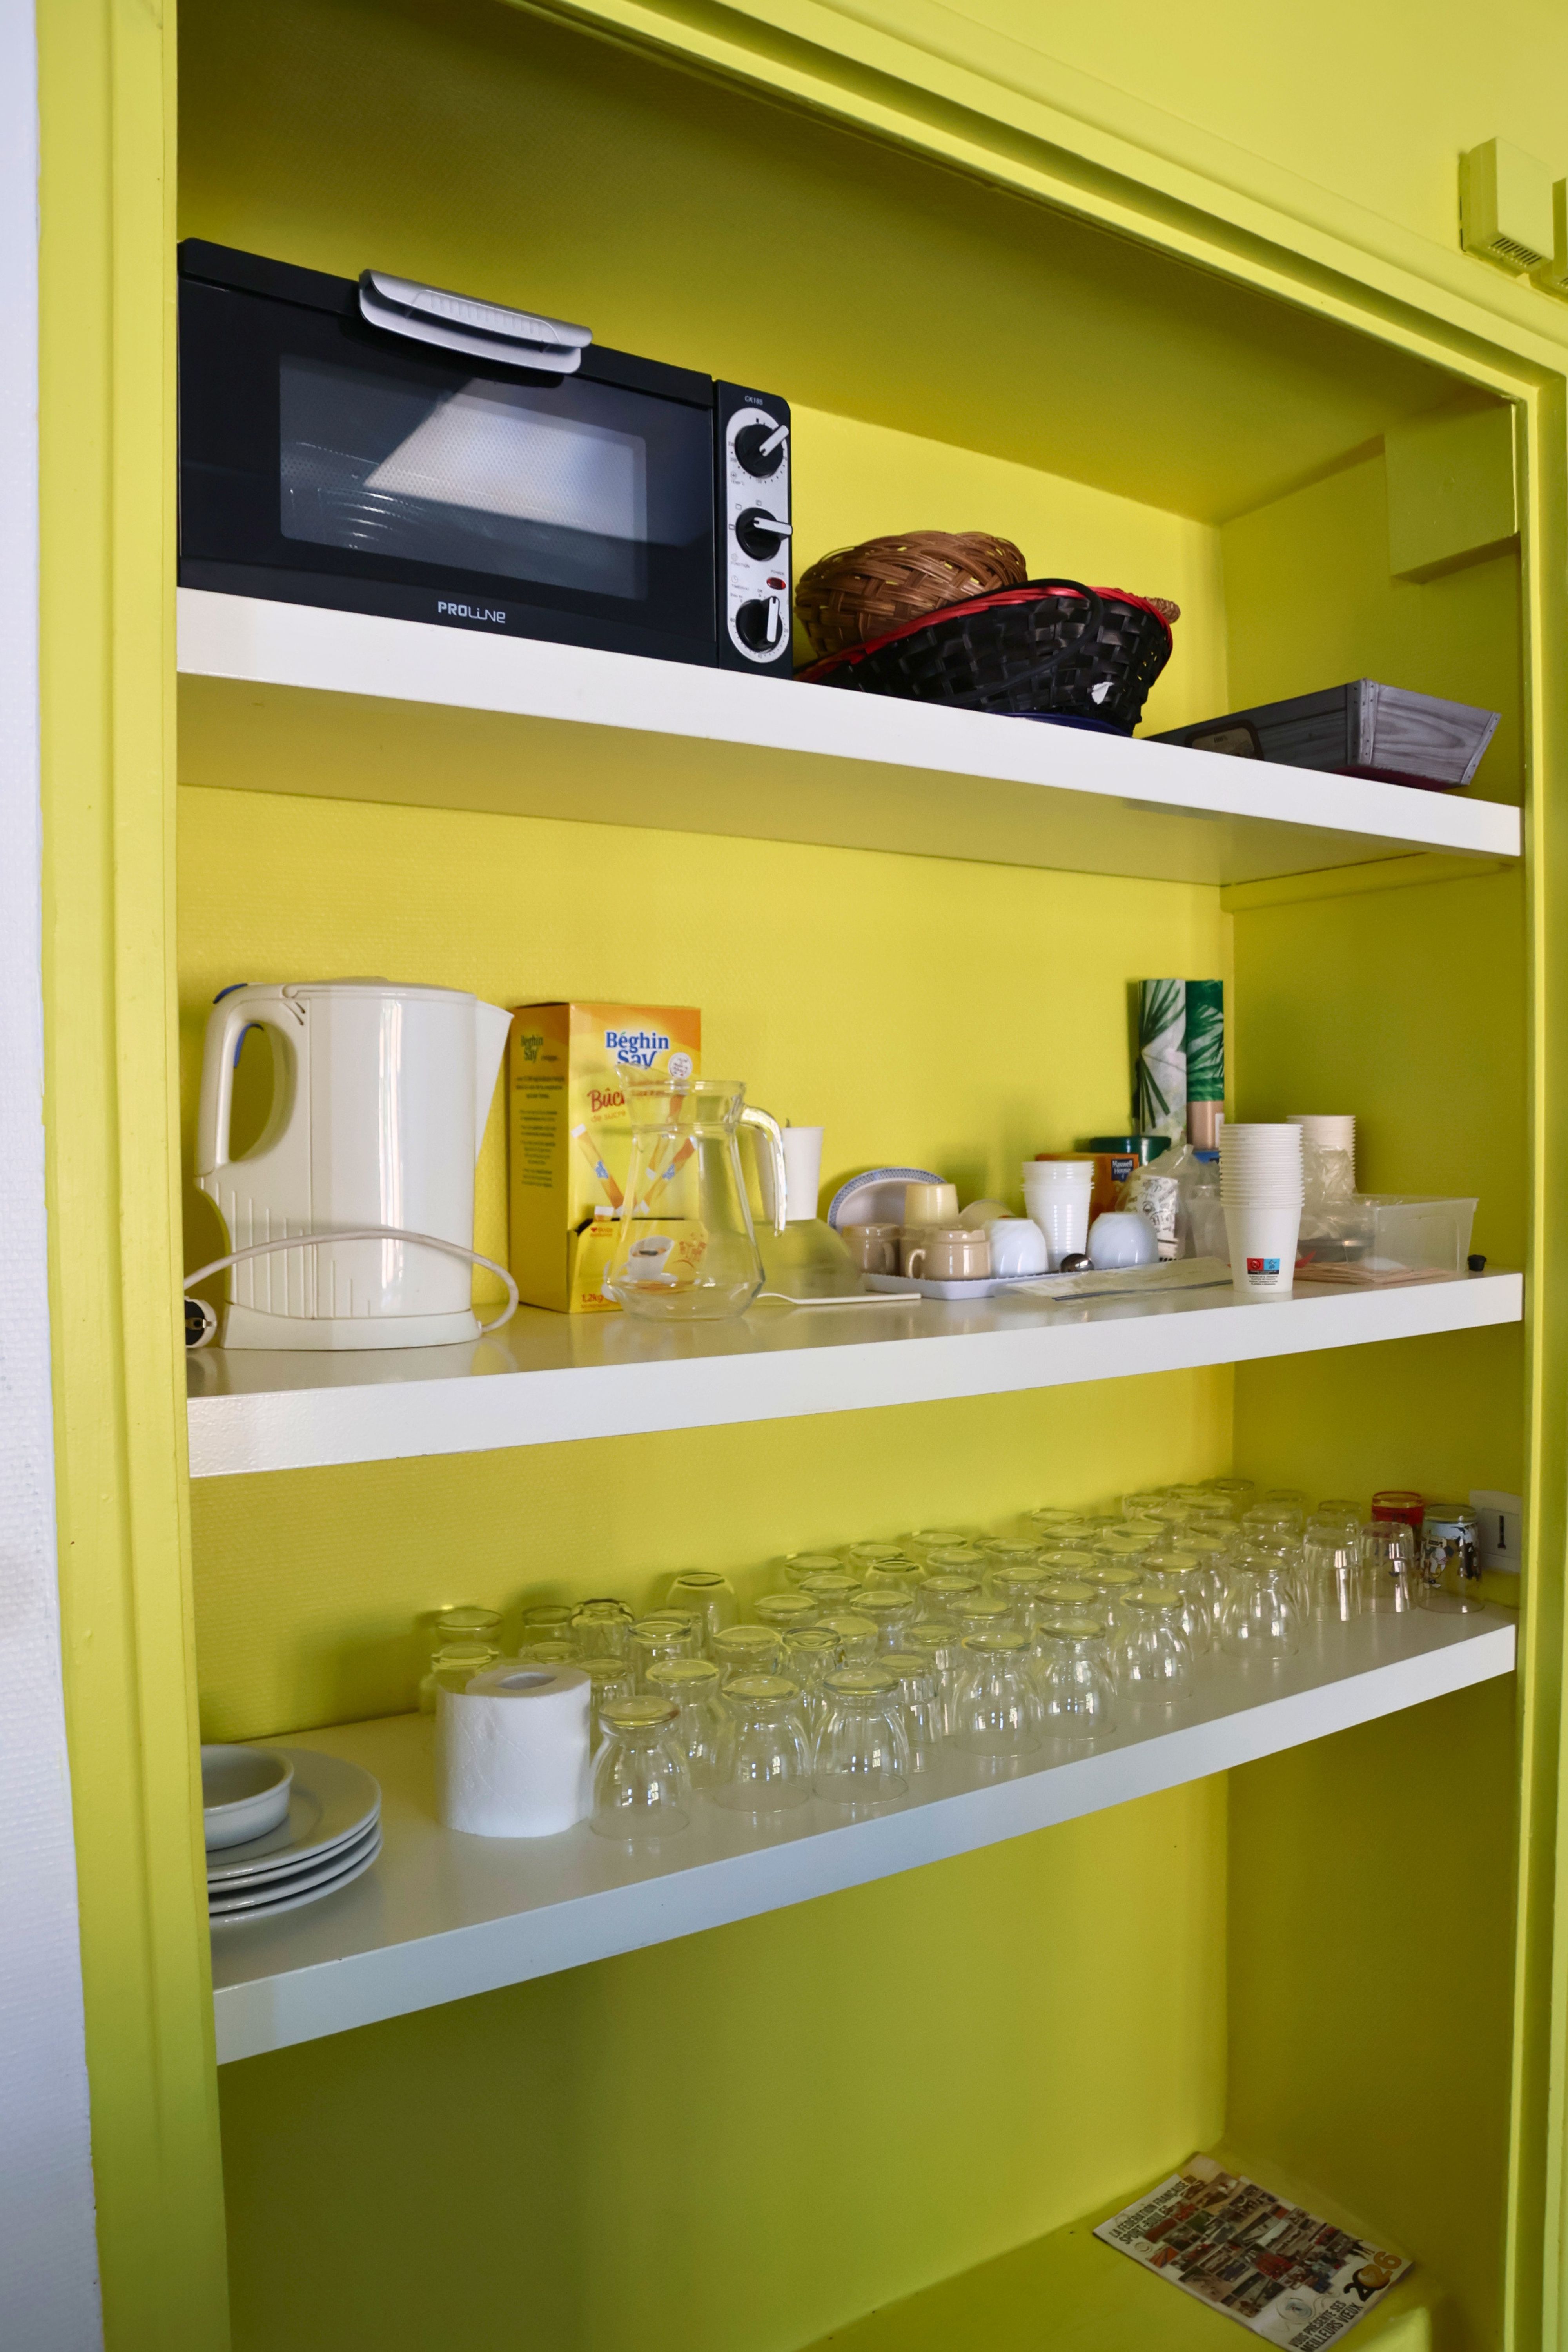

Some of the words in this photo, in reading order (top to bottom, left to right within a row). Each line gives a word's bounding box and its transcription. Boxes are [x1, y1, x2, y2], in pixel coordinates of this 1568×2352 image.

[606, 1031, 669, 1053] Béghin
[1288, 2332, 1309, 2347] VOUS
[1303, 2309, 1336, 2336] PRÉSENTE
[1330, 2300, 1347, 2313] SES
[1299, 2319, 1344, 2352] MEILLEURS
